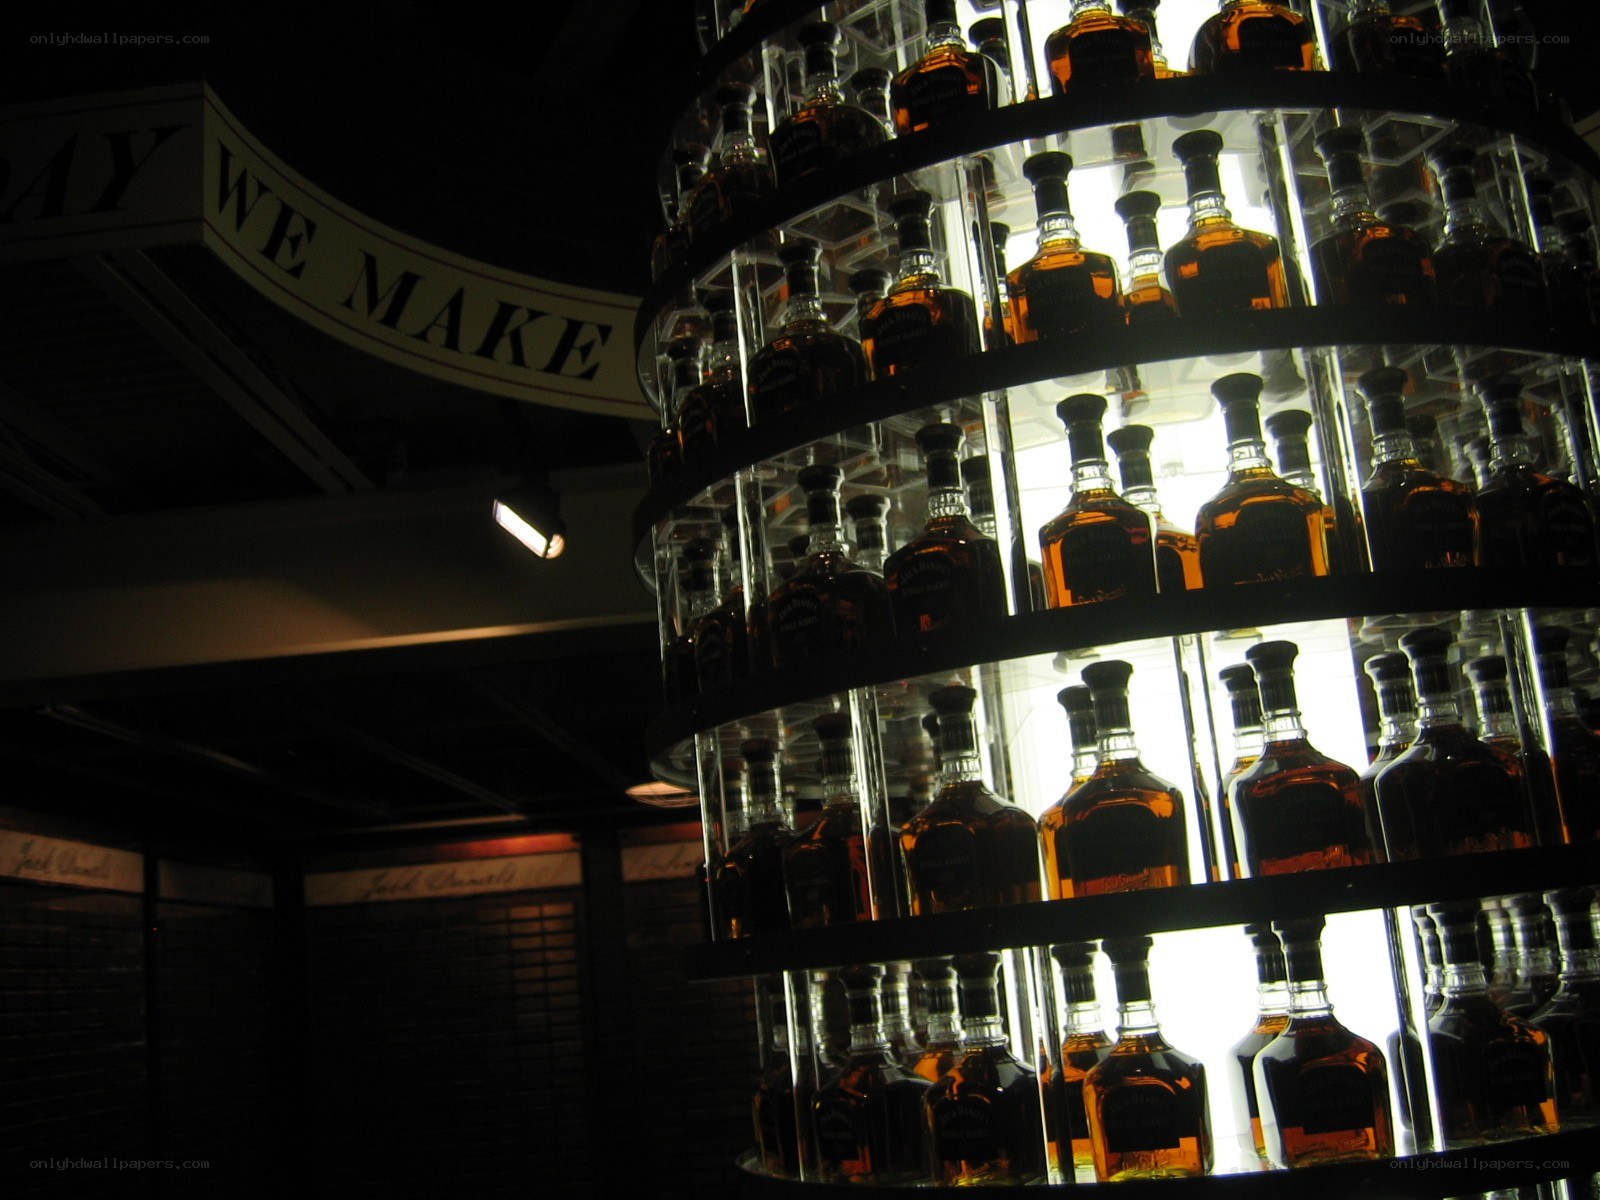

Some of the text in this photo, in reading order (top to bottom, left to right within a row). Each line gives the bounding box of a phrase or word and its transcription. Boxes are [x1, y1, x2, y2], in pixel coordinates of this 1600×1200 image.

[0, 124, 193, 223] AY
[217, 138, 613, 381] WE MAKE
